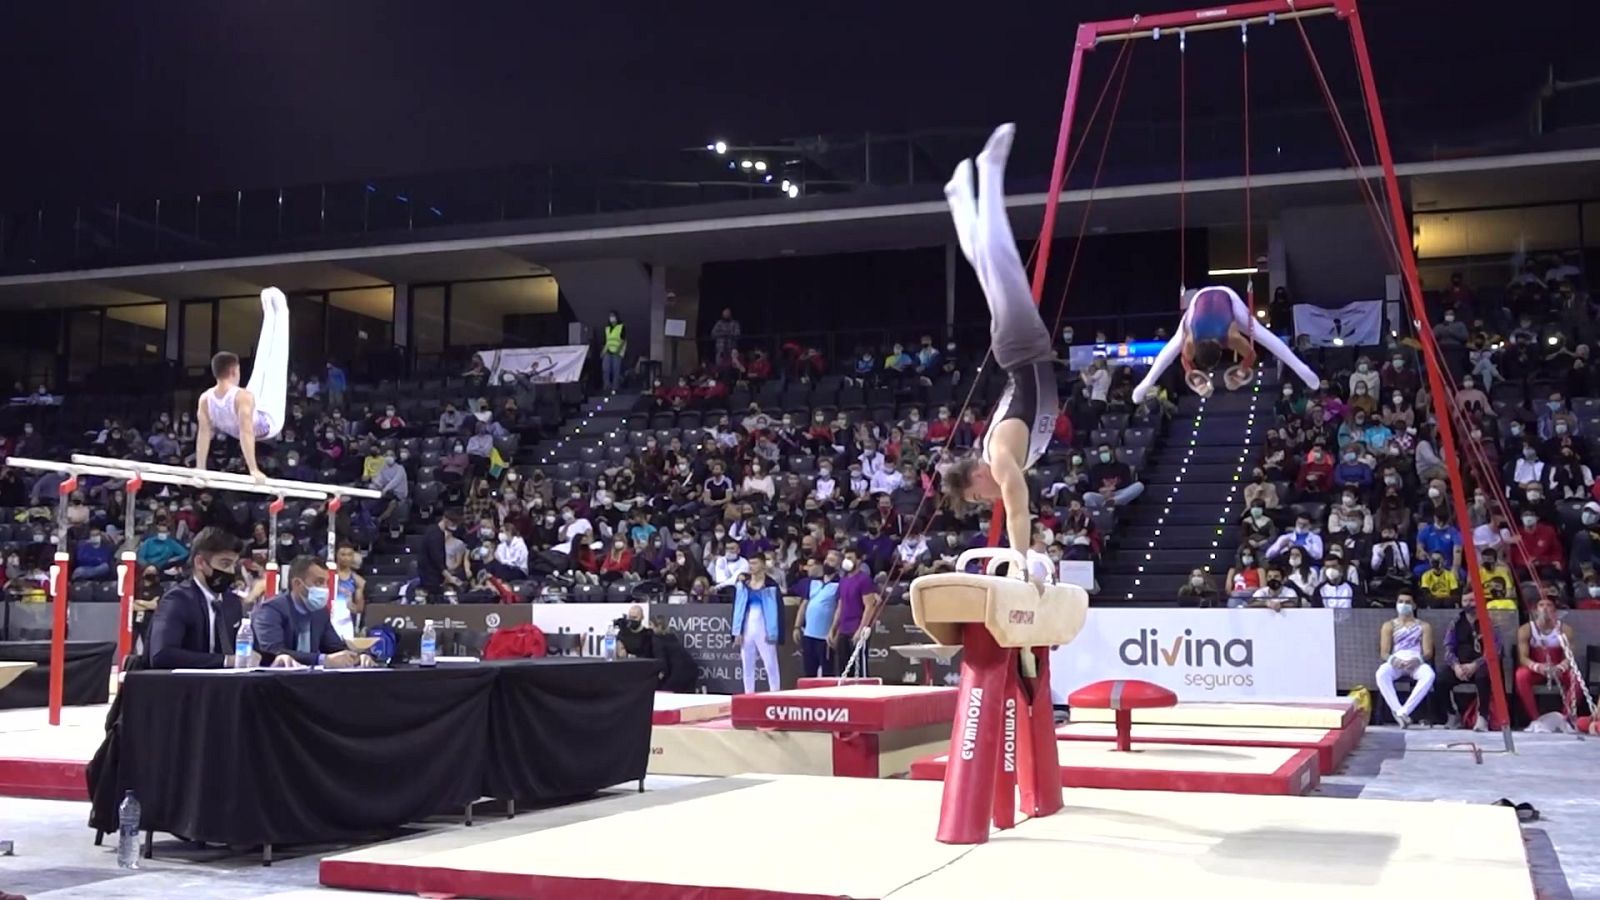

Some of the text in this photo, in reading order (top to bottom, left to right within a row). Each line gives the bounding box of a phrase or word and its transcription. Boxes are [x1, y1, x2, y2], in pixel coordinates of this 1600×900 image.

[683, 633, 739, 649] DE ESP
[1119, 628, 1253, 667] divina
[734, 667, 767, 681] BSE
[1185, 674, 1254, 691] seguros
[765, 706, 849, 723] GYMNOVA
[961, 687, 983, 760] GYMNOVA
[1004, 698, 1016, 772] GYMNOVA
